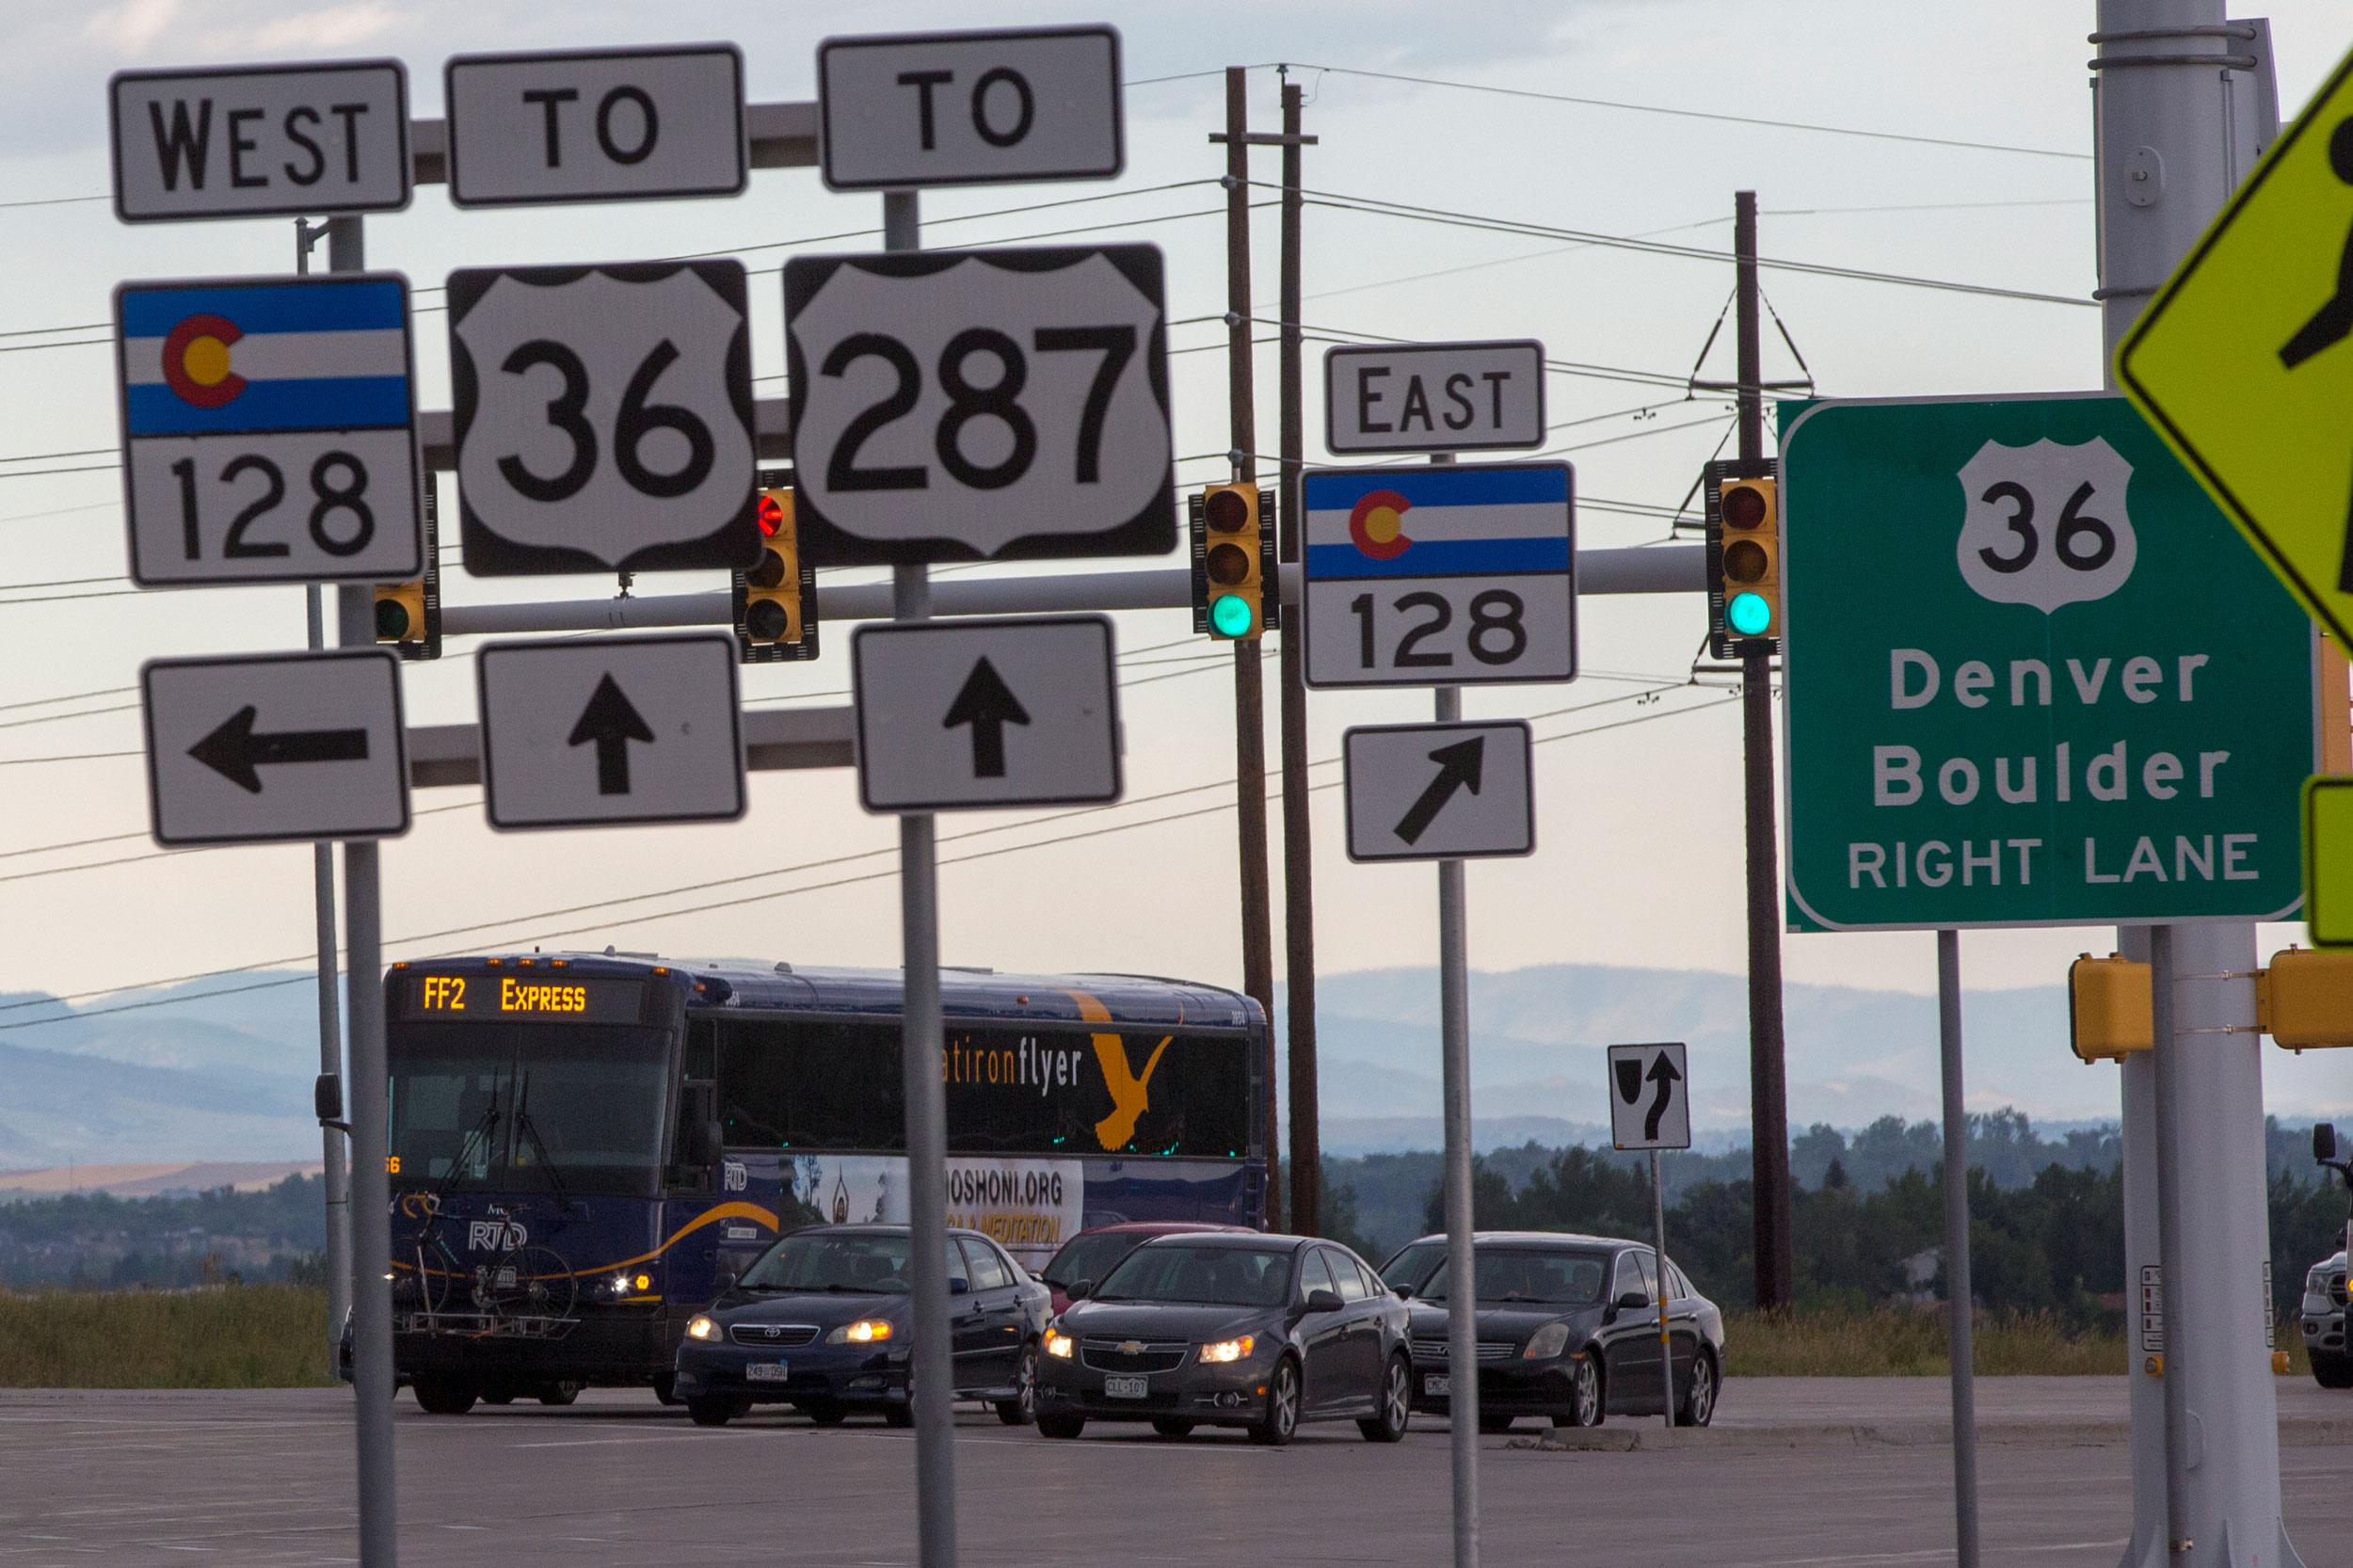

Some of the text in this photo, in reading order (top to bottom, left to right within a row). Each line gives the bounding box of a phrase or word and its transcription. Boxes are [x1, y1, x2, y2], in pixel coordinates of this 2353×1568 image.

[148, 98, 369, 192] WEST
[521, 84, 659, 169] TO
[896, 66, 1035, 152] TO
[496, 337, 715, 503] 36
[819, 324, 1138, 493] 287
[1357, 365, 1512, 434] EAST
[170, 450, 376, 560] 128
[1977, 480, 2117, 574] 36
[1350, 588, 1529, 669] 128
[1889, 648, 2211, 710] Denver
[1872, 739, 2232, 807] Boulder
[1847, 832, 2260, 889] RIGHT LANE
[424, 977, 466, 1010] FF2
[724, 1162, 747, 1192] RTD
[469, 1221, 528, 1252] RTD
